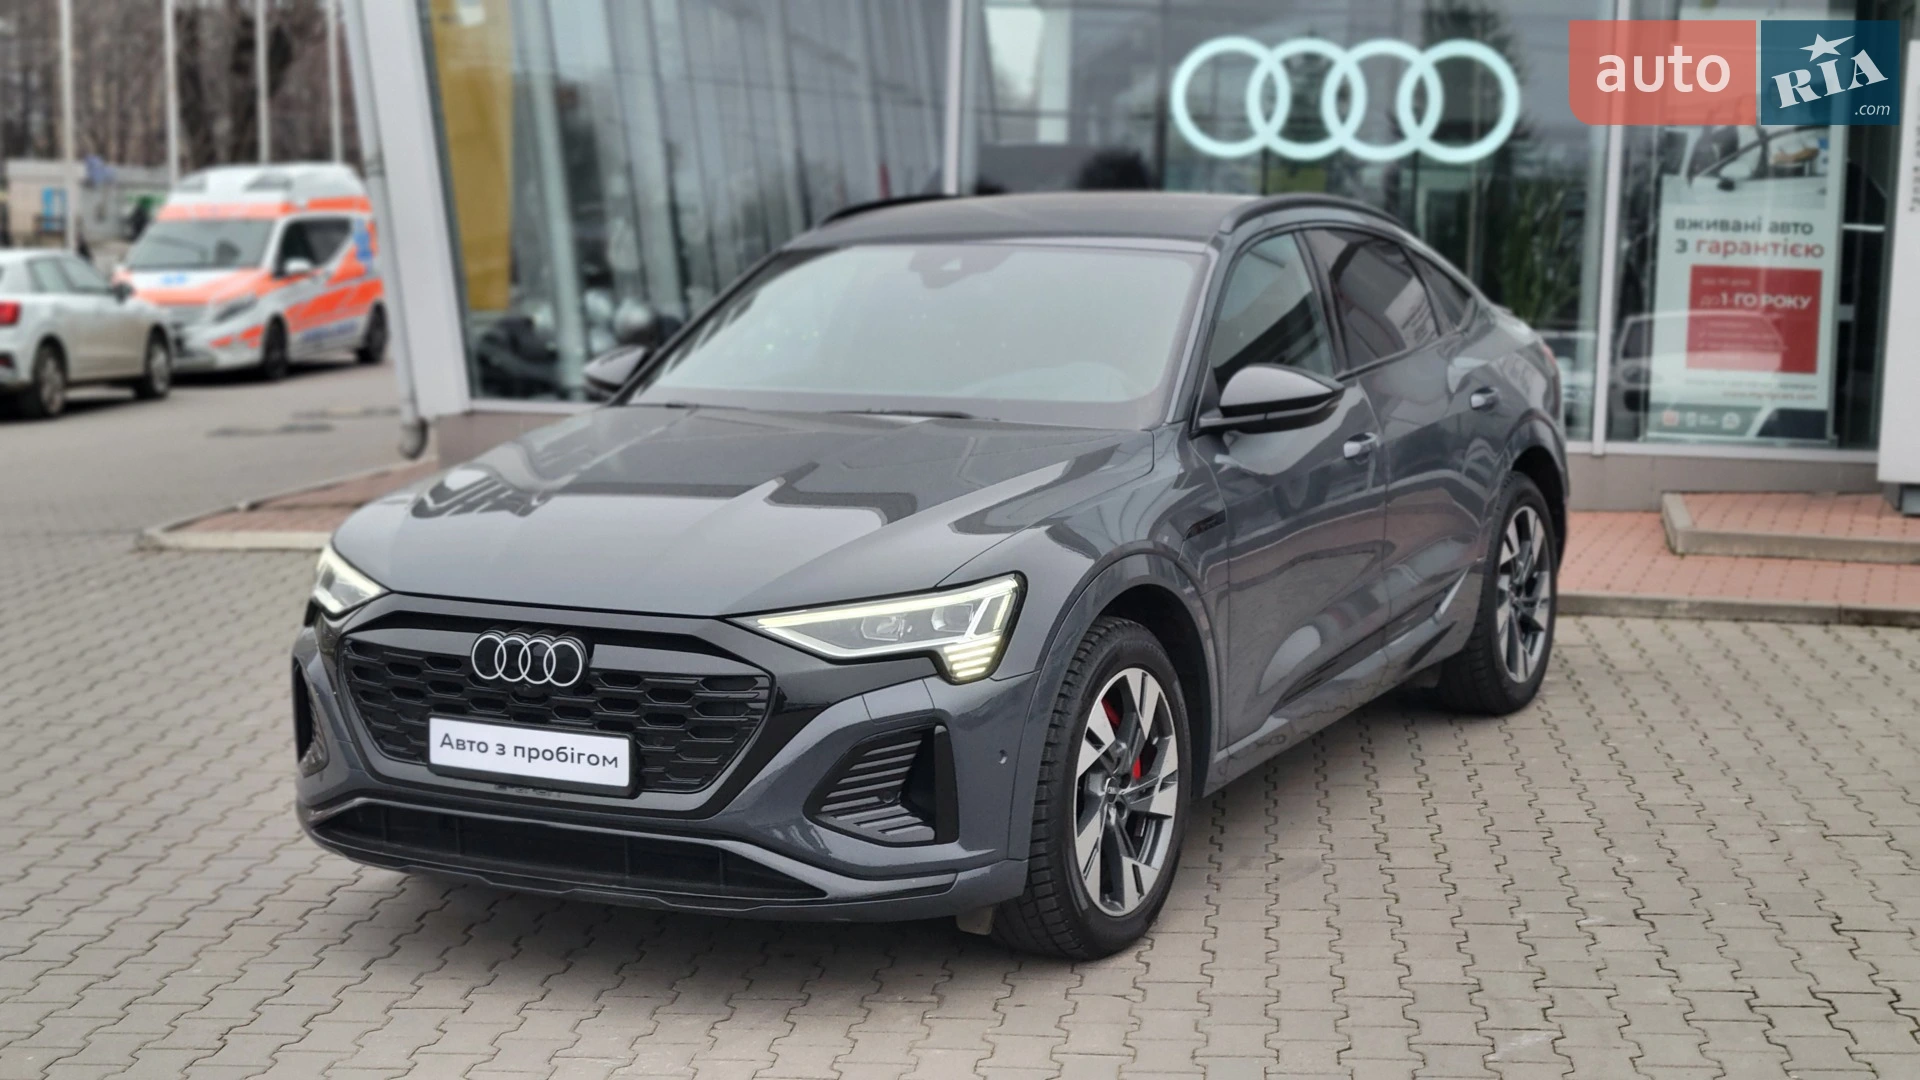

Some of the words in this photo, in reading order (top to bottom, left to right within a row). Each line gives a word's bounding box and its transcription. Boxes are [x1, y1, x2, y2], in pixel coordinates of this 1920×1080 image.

[1674, 216, 1763, 233] вживані
[1768, 219, 1814, 236] авто
[1696, 239, 1825, 259] гарантією
[1760, 293, 1812, 311] РОКУ
[439, 732, 489, 754] Авто
[495, 743, 506, 756] з
[513, 744, 619, 769] пробігом
